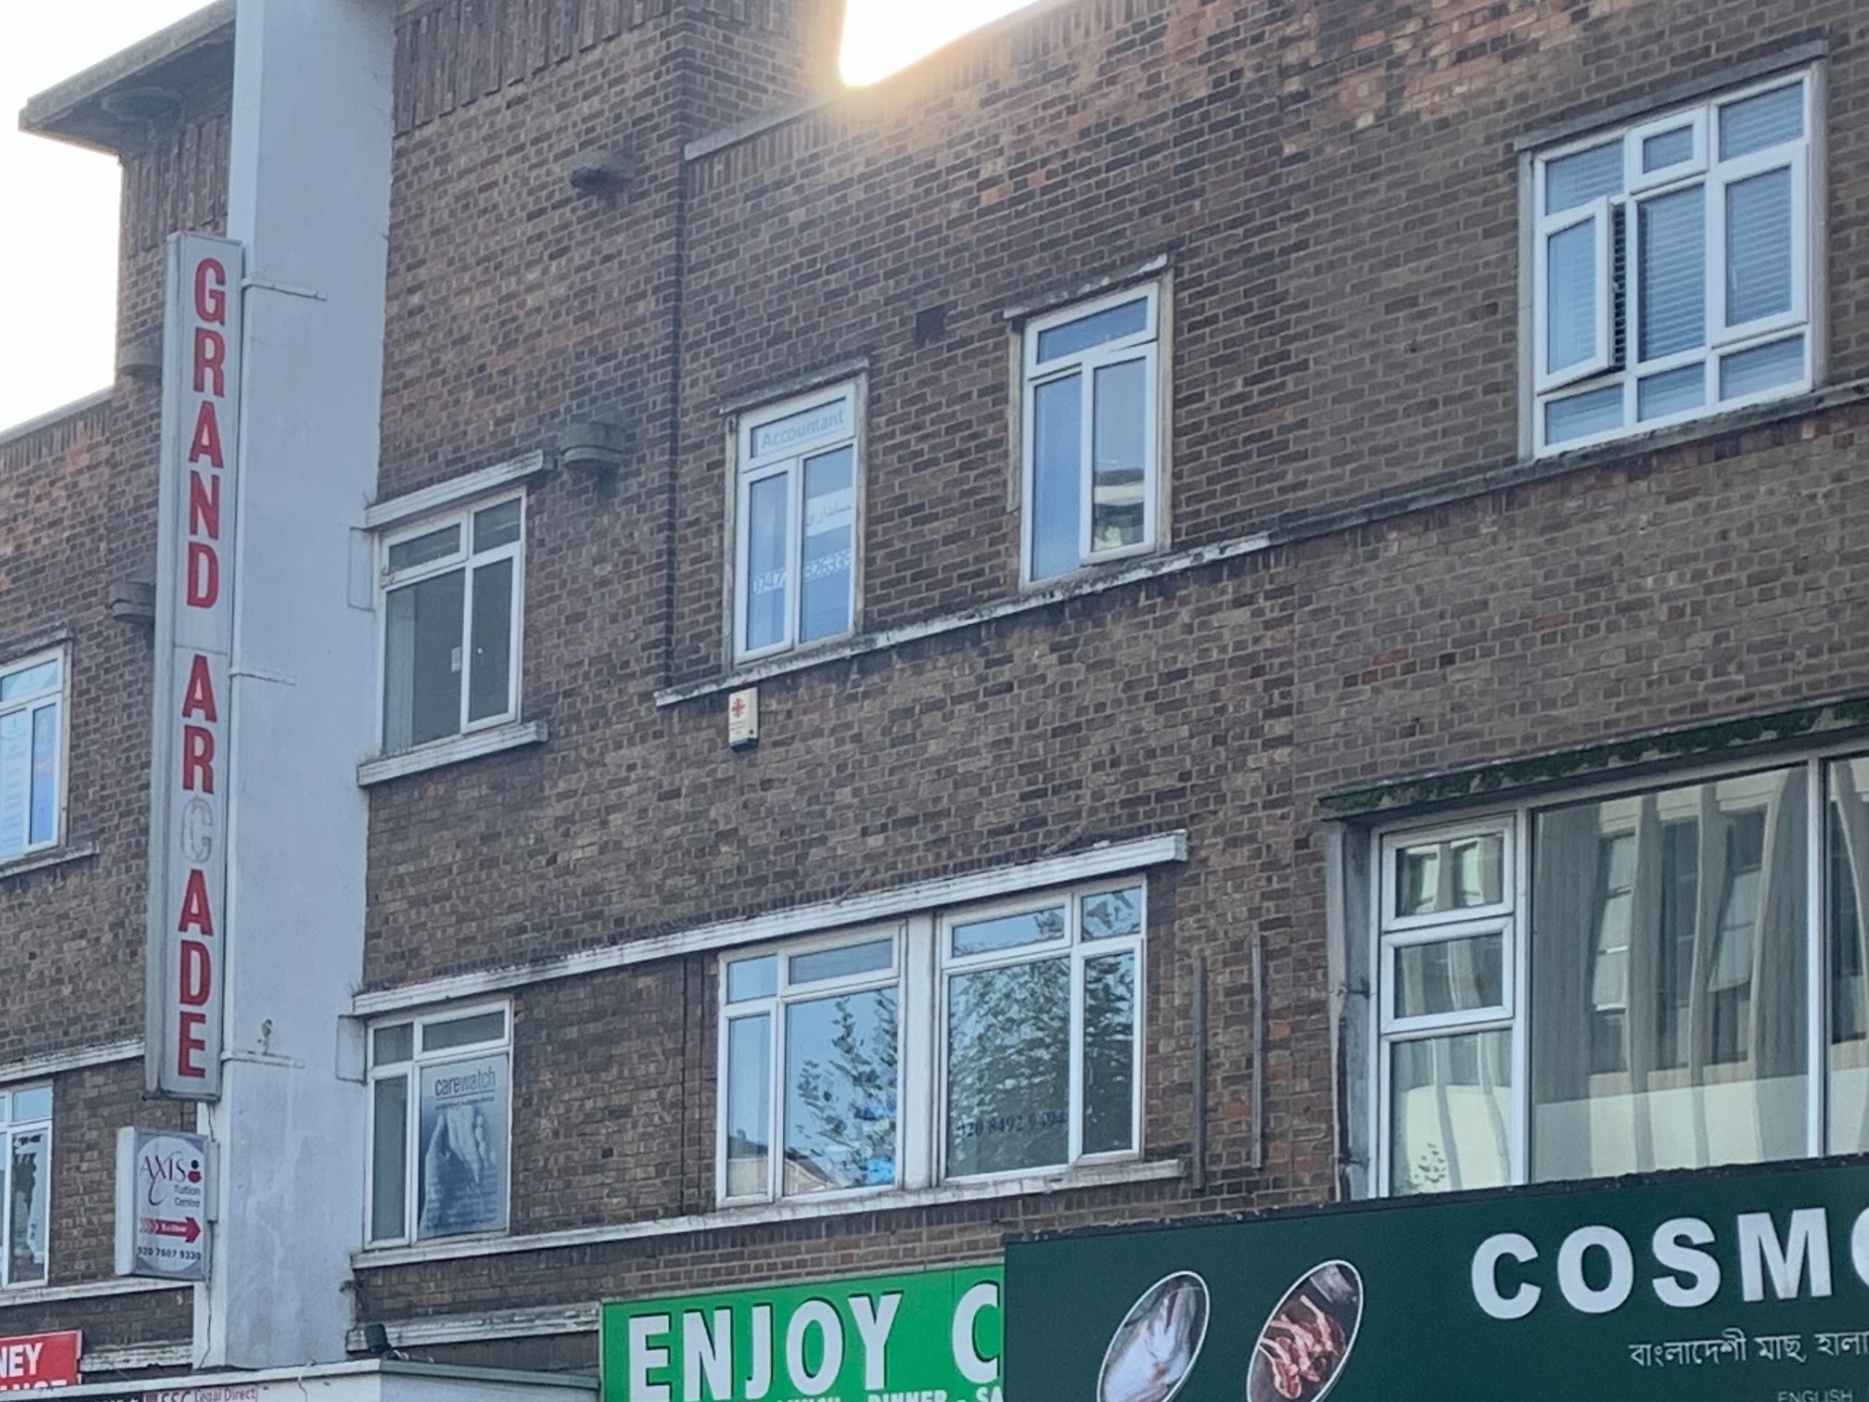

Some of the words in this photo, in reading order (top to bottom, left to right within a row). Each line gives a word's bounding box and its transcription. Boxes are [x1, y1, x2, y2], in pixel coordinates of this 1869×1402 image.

[186, 256, 228, 610] GRAND
[435, 1066, 496, 1097] carewatch
[174, 1185, 201, 1196] Tuition
[175, 1196, 201, 1208] Centre
[1471, 1206, 1869, 1320] COSM
[1629, 1327, 1747, 1367] বাংলাদেশী
[224, 1386, 257, 1402] Direct
